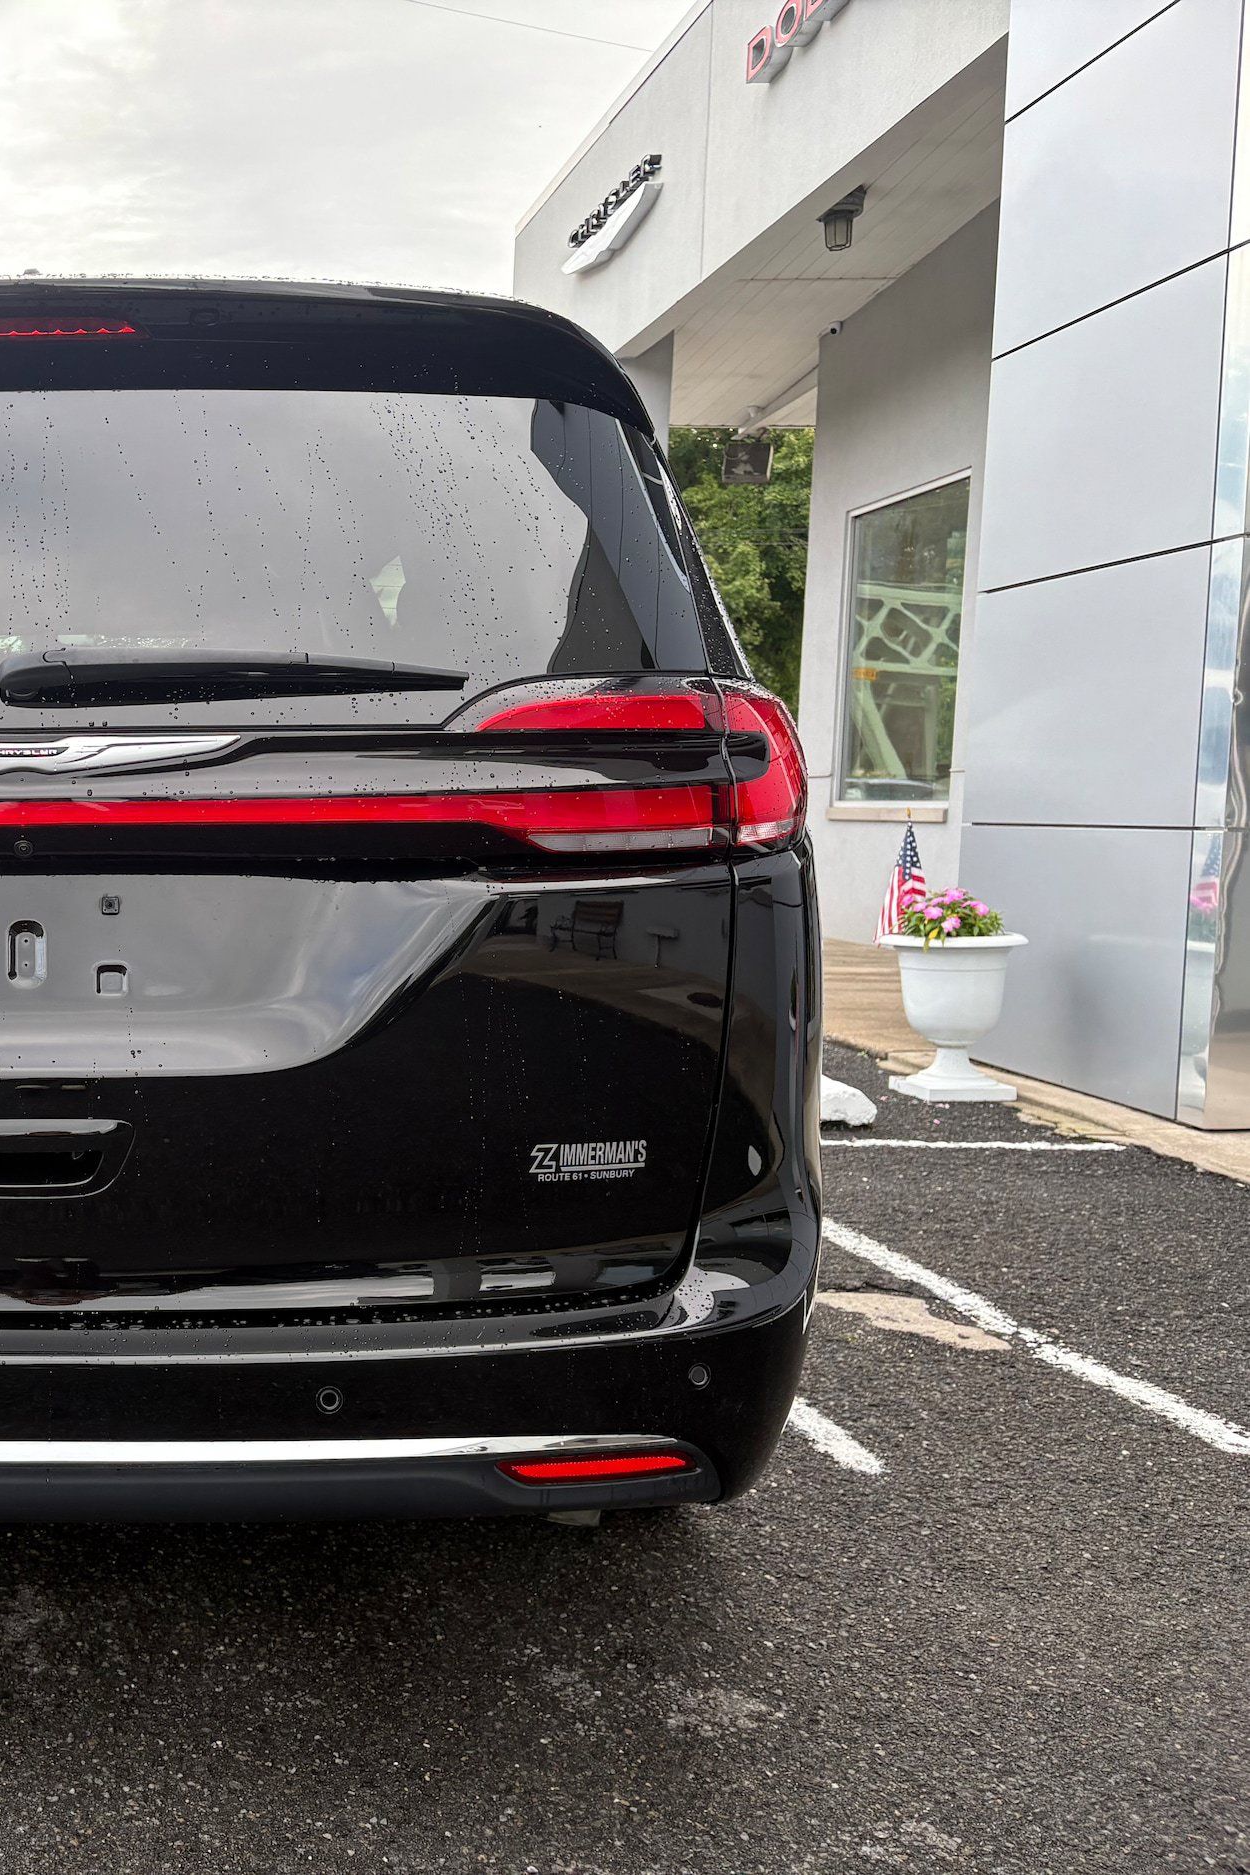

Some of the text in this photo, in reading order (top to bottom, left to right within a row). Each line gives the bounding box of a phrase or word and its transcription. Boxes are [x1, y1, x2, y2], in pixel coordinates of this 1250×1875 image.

[746, 0, 832, 84] DO
[538, 1173, 570, 1182] ROUTE
[590, 1169, 635, 1180] SUNBURY
